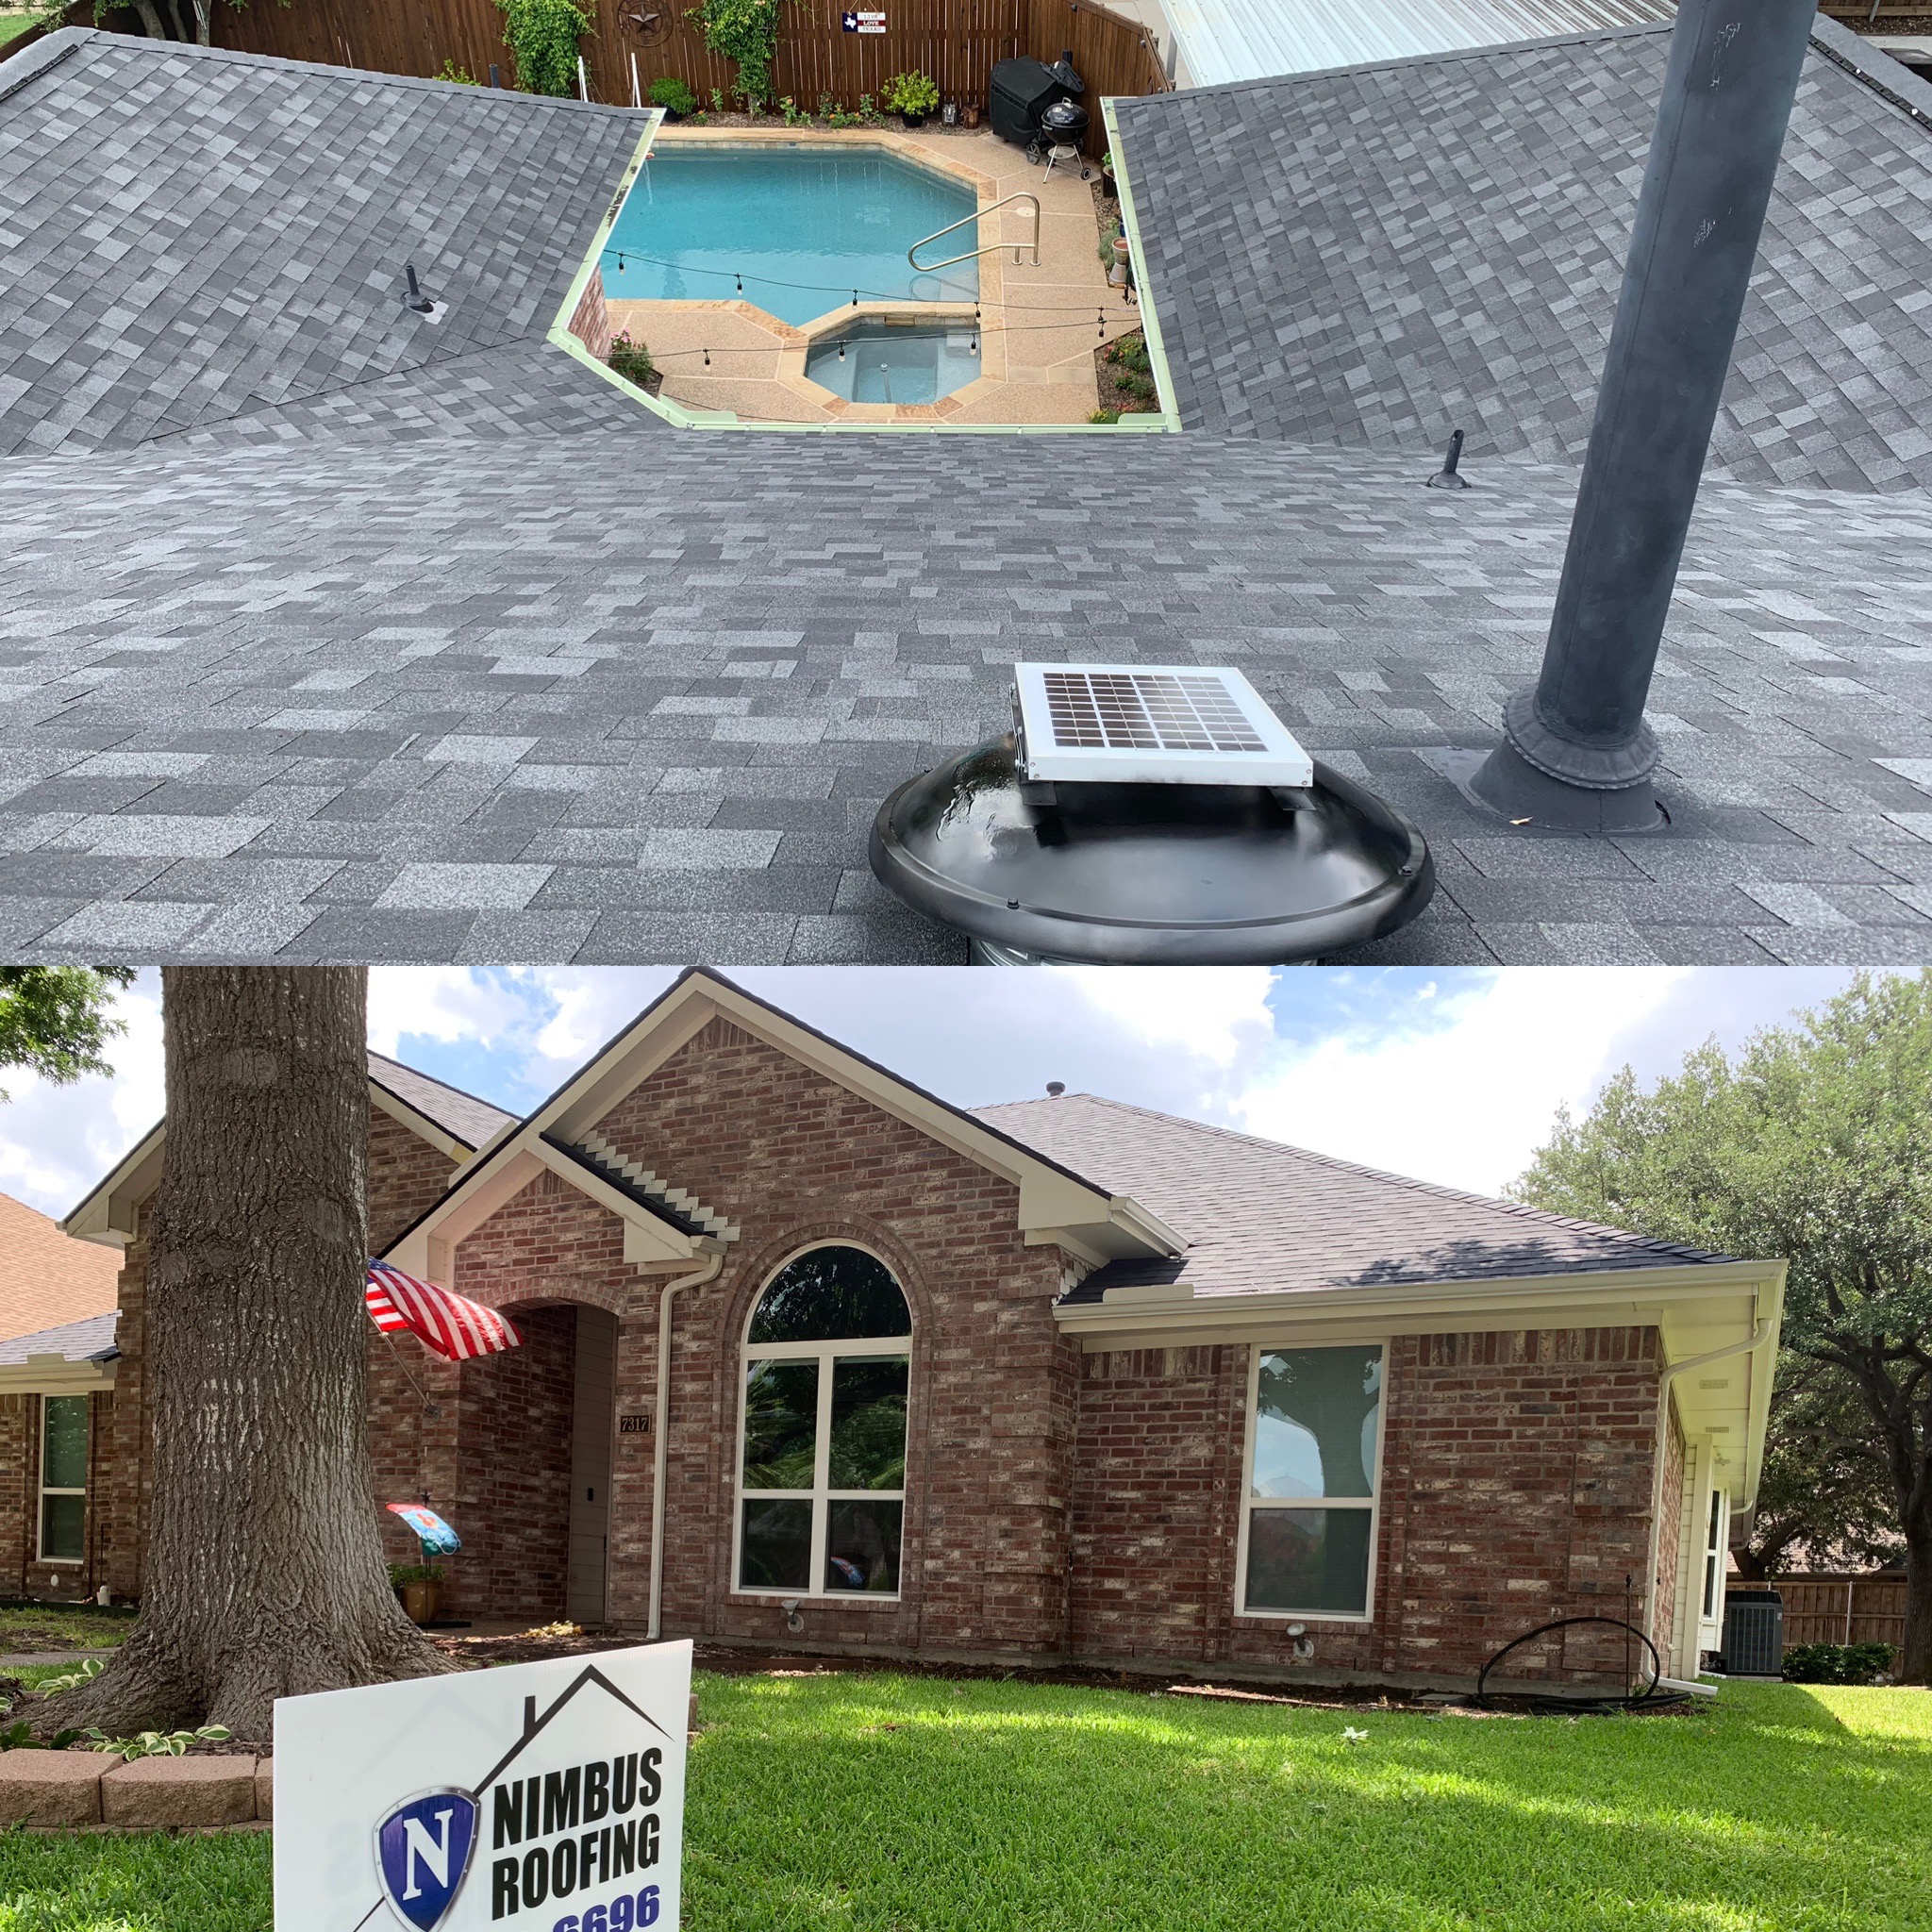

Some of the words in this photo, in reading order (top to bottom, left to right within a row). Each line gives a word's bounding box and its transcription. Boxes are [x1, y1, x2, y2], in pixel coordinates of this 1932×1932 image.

[622, 1417, 647, 1432] 7317
[492, 1747, 663, 1850] NIMBUS
[402, 1808, 453, 1901] N
[492, 1813, 660, 1921] ROOFING
